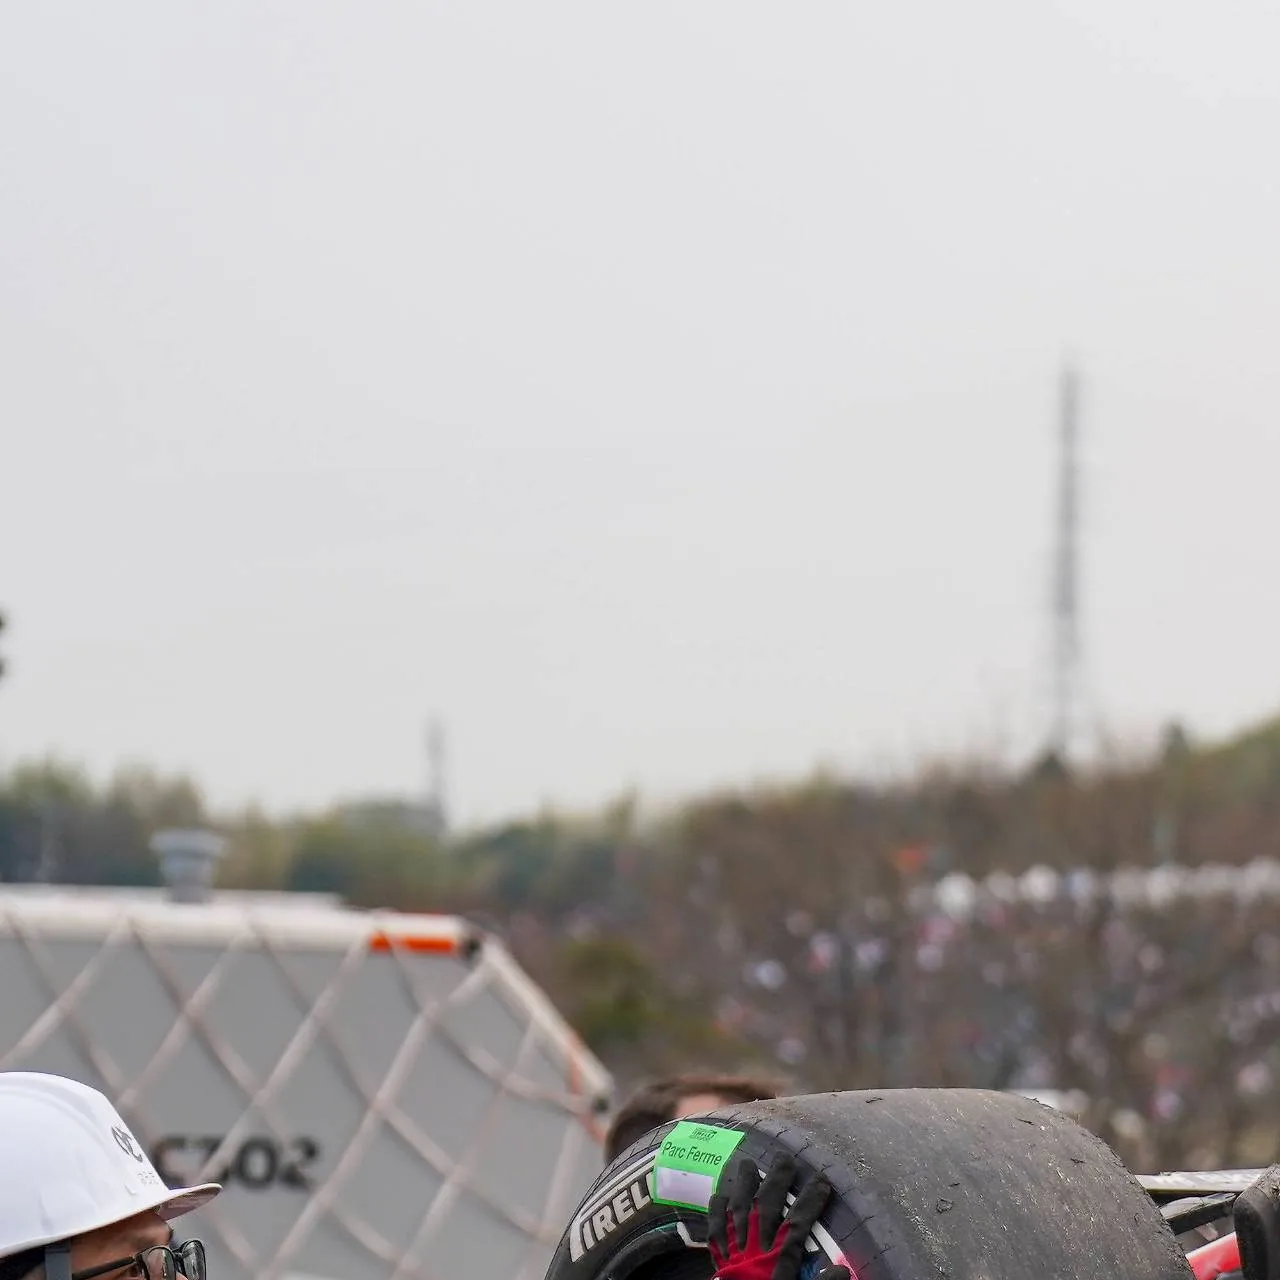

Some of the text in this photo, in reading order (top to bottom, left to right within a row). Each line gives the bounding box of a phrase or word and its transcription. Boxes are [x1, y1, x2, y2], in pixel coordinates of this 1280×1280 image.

[661, 1141, 723, 1166] Parc Ferme
[569, 1148, 661, 1263] PIREL
